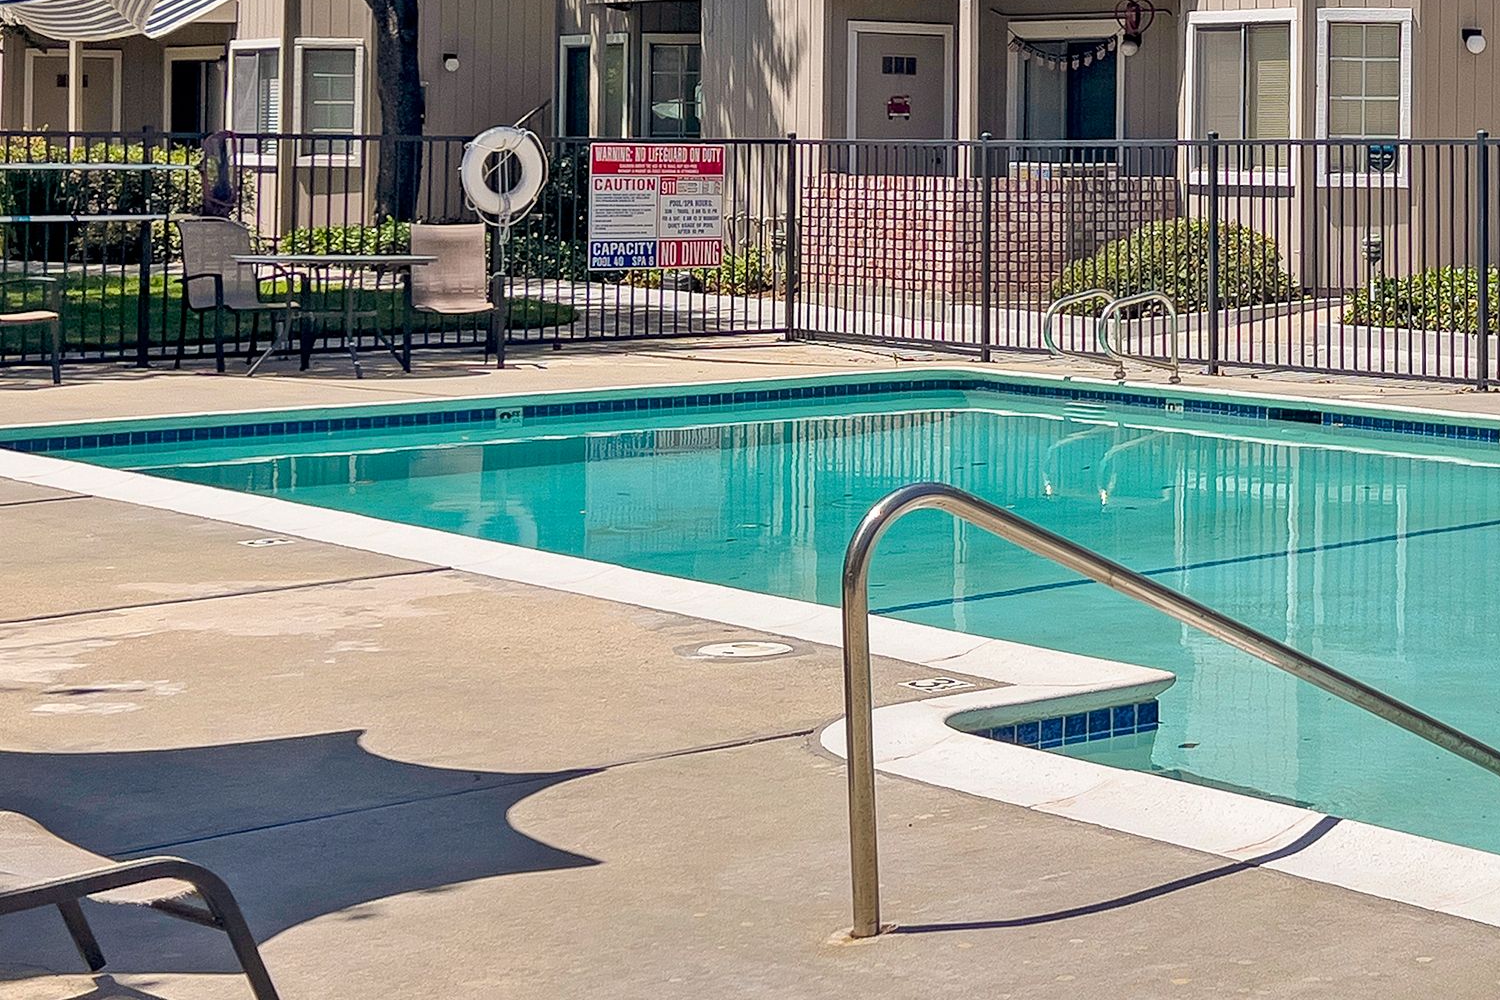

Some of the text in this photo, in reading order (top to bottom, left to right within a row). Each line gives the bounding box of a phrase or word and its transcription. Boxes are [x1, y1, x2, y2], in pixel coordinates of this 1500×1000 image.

[594, 146, 722, 163] WARNING: NO LIFEGUARD ON DUTY
[594, 178, 656, 191] CAUTION
[661, 181, 676, 194] 911
[592, 242, 654, 256] CAPACITY
[660, 240, 720, 266] NO DIVING
[592, 256, 612, 267] POOL
[631, 256, 646, 266] SPA
[648, 256, 655, 266] 8
